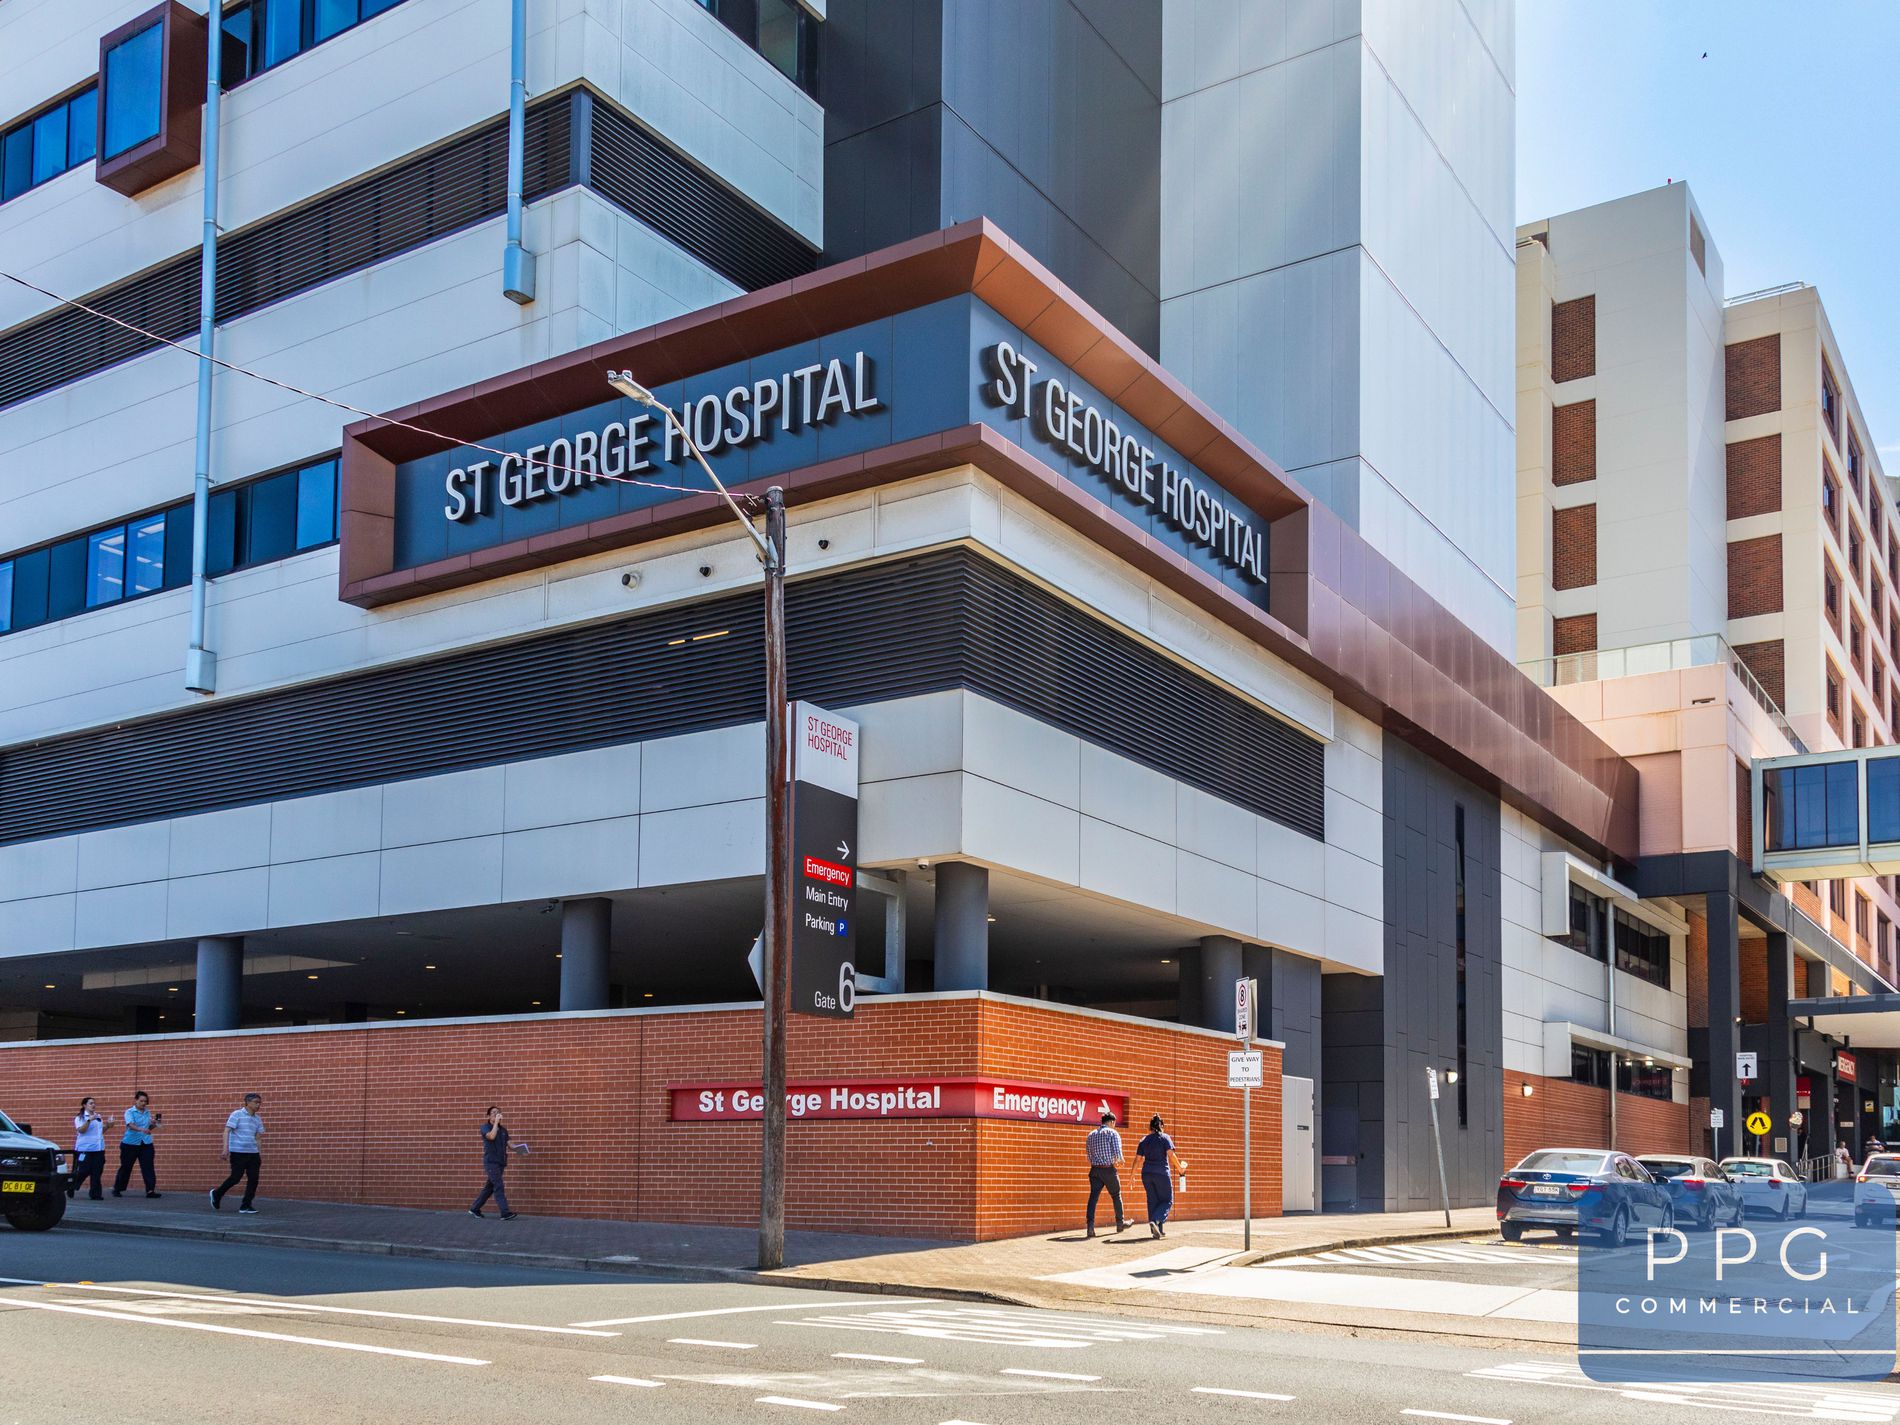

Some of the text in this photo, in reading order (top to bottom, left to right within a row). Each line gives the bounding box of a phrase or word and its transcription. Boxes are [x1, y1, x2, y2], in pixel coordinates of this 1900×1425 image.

[445, 351, 877, 521] ST GEORGE HOSPITAL
[997, 342, 1267, 584] ST GEORGE HOSPITAL
[808, 716, 853, 747] ST GEORGE
[808, 732, 848, 761] HOSPITAL
[806, 858, 850, 886] Emergency
[806, 886, 849, 912] Main Entry
[805, 912, 835, 936] Parking
[814, 961, 855, 1012] Gate 6
[699, 1086, 940, 1116] St Gege Hospital
[993, 1086, 1087, 1121] Emergency
